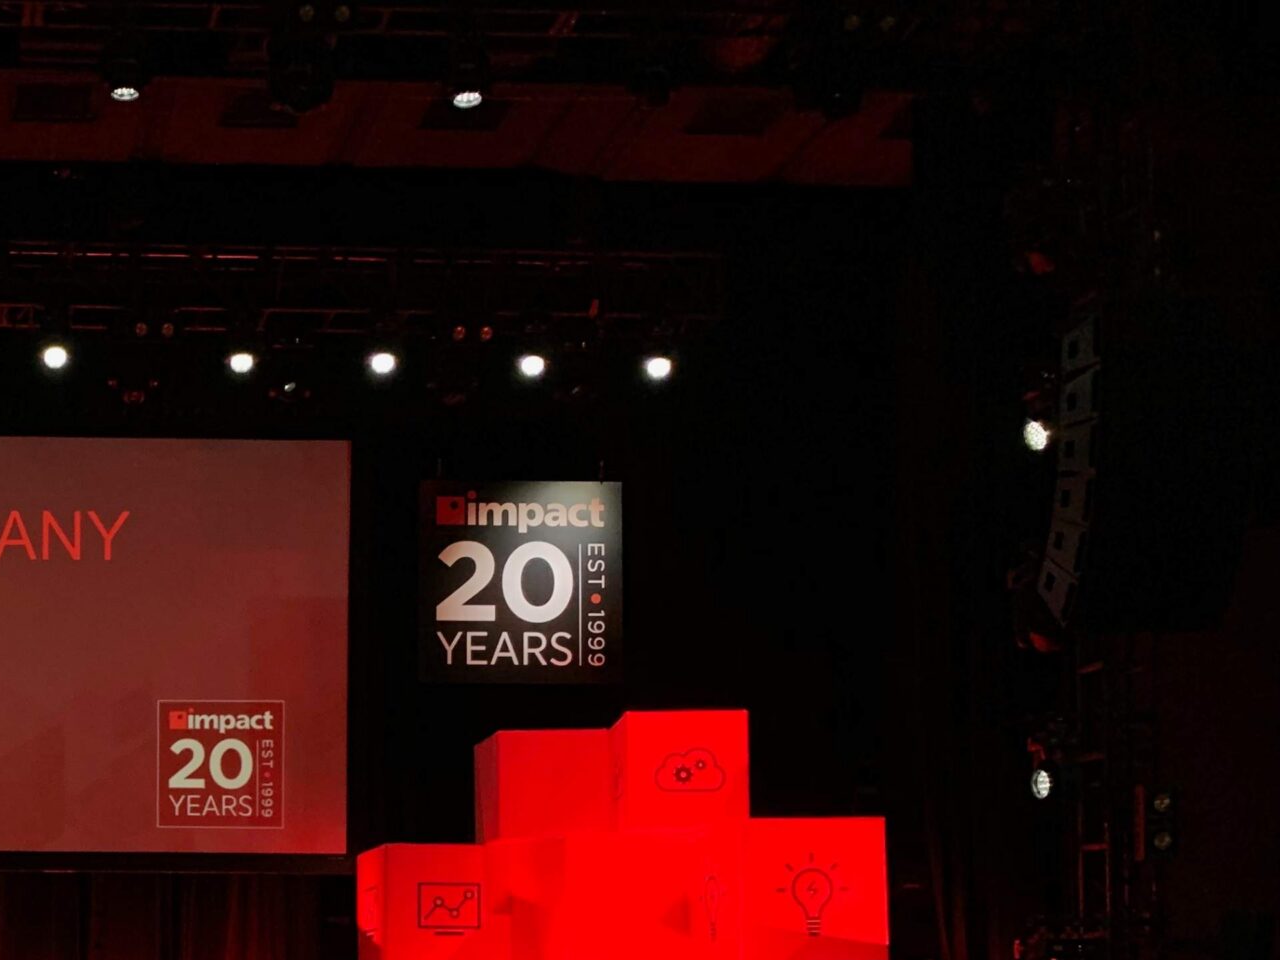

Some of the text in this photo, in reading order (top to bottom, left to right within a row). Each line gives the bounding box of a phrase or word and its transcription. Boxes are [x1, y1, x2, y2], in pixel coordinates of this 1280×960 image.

[466, 490, 605, 534] impact
[436, 540, 574, 624] 20
[436, 631, 573, 667] YEARS
[587, 609, 606, 667] 1999
[187, 708, 274, 735] impact
[168, 738, 253, 790] 20
[168, 794, 253, 817] YEARS
[261, 781, 274, 818] 1999
